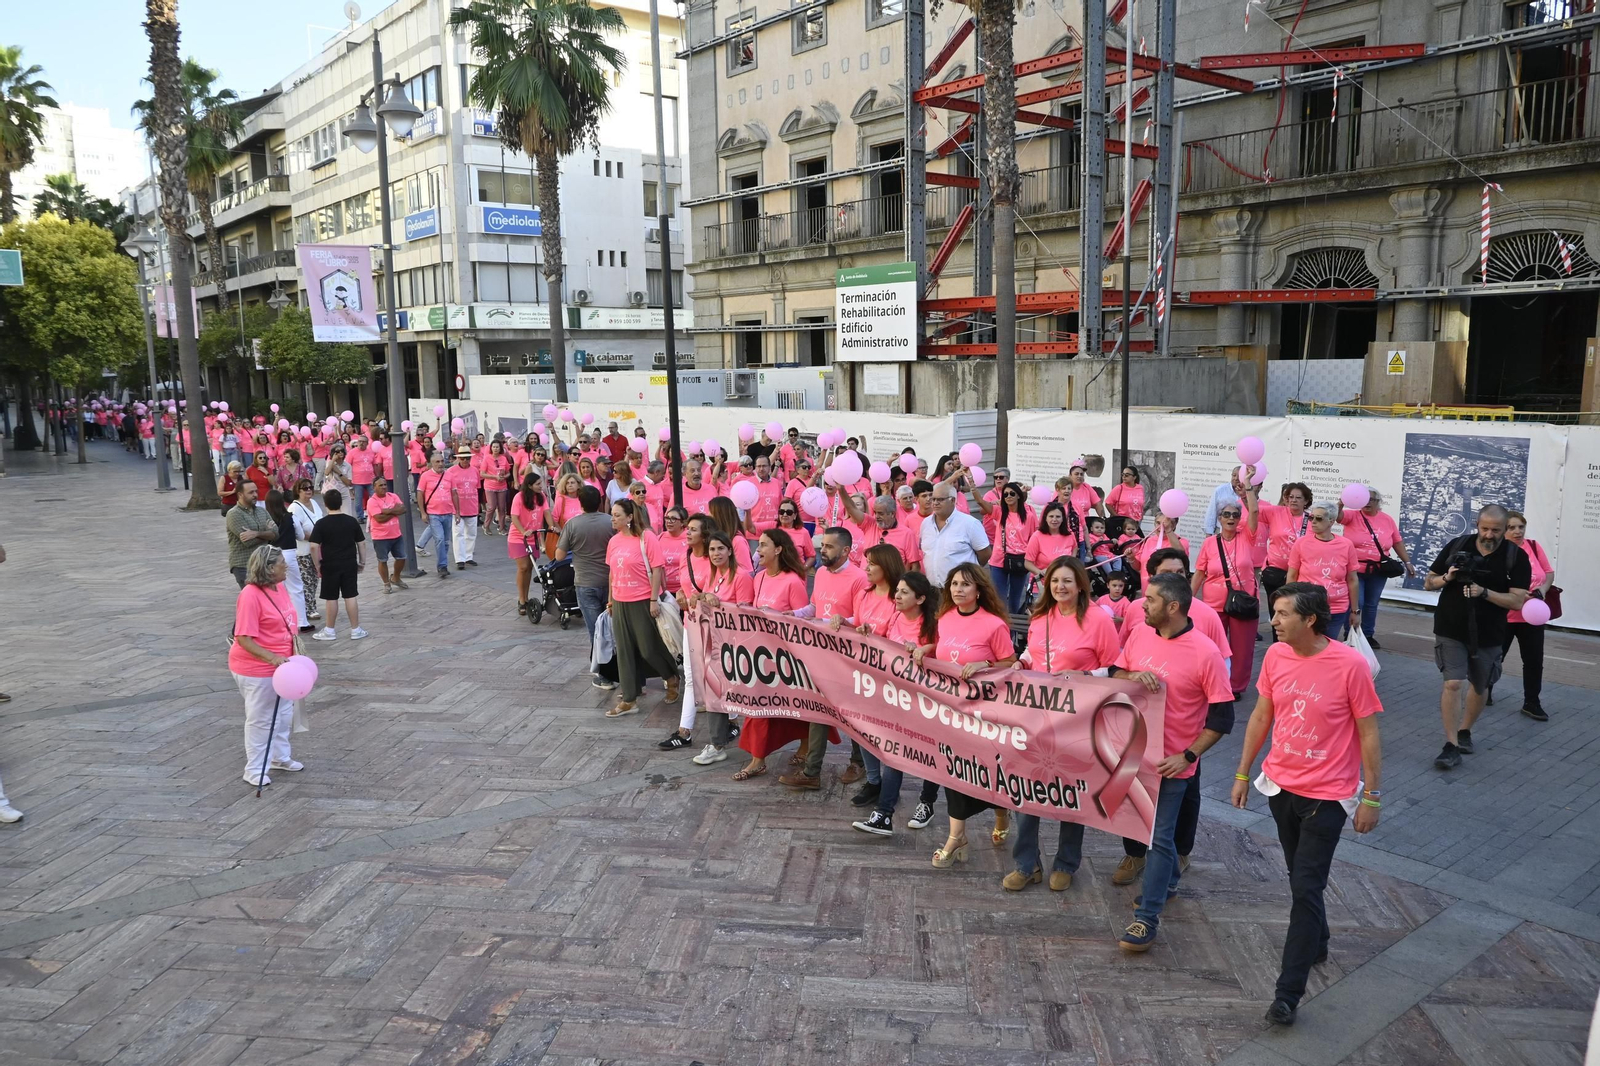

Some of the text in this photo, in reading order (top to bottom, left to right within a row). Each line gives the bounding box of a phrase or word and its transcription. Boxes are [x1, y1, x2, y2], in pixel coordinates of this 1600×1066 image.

[407, 217, 434, 235] mediolanum
[489, 212, 541, 229] mediolan
[310, 250, 333, 259] FERIA
[325, 258, 348, 267] LIBRO
[840, 289, 897, 304] Terminación
[841, 304, 906, 319] Rehabilitación
[324, 317, 365, 325] HUELVA
[841, 322, 873, 334] Edificio
[841, 335, 909, 348] Administrativo
[597, 352, 634, 364] cajamar
[682, 376, 702, 384] PICOTE
[1183, 441, 1199, 449] Unos
[1303, 438, 1357, 451] El proyecto
[1183, 449, 1220, 457] importancia
[1302, 466, 1340, 474] emblemático
[1310, 475, 1337, 483] Dirección
[1313, 557, 1339, 568] Unidos
[943, 636, 972, 652] Unidos
[713, 607, 1077, 714] DÍA INTERNACIONAL DEL CÁNCER DE MAMA
[1138, 655, 1170, 678] Unidos
[1282, 679, 1323, 702] Unidos
[726, 704, 801, 718] www.aocamhuelva.es
[852, 669, 1028, 751] 19 de Octubre
[725, 691, 790, 710] ASOCIACIÓN
[792, 698, 839, 721] ONUBENSE
[883, 739, 900, 756] DE
[902, 745, 937, 769] MAMA
[861, 713, 894, 731] amanecer
[894, 722, 903, 734] de
[903, 726, 936, 746] esperanza
[1290, 722, 1319, 742] Vida
[938, 741, 1088, 812] “Santa Águeda”
